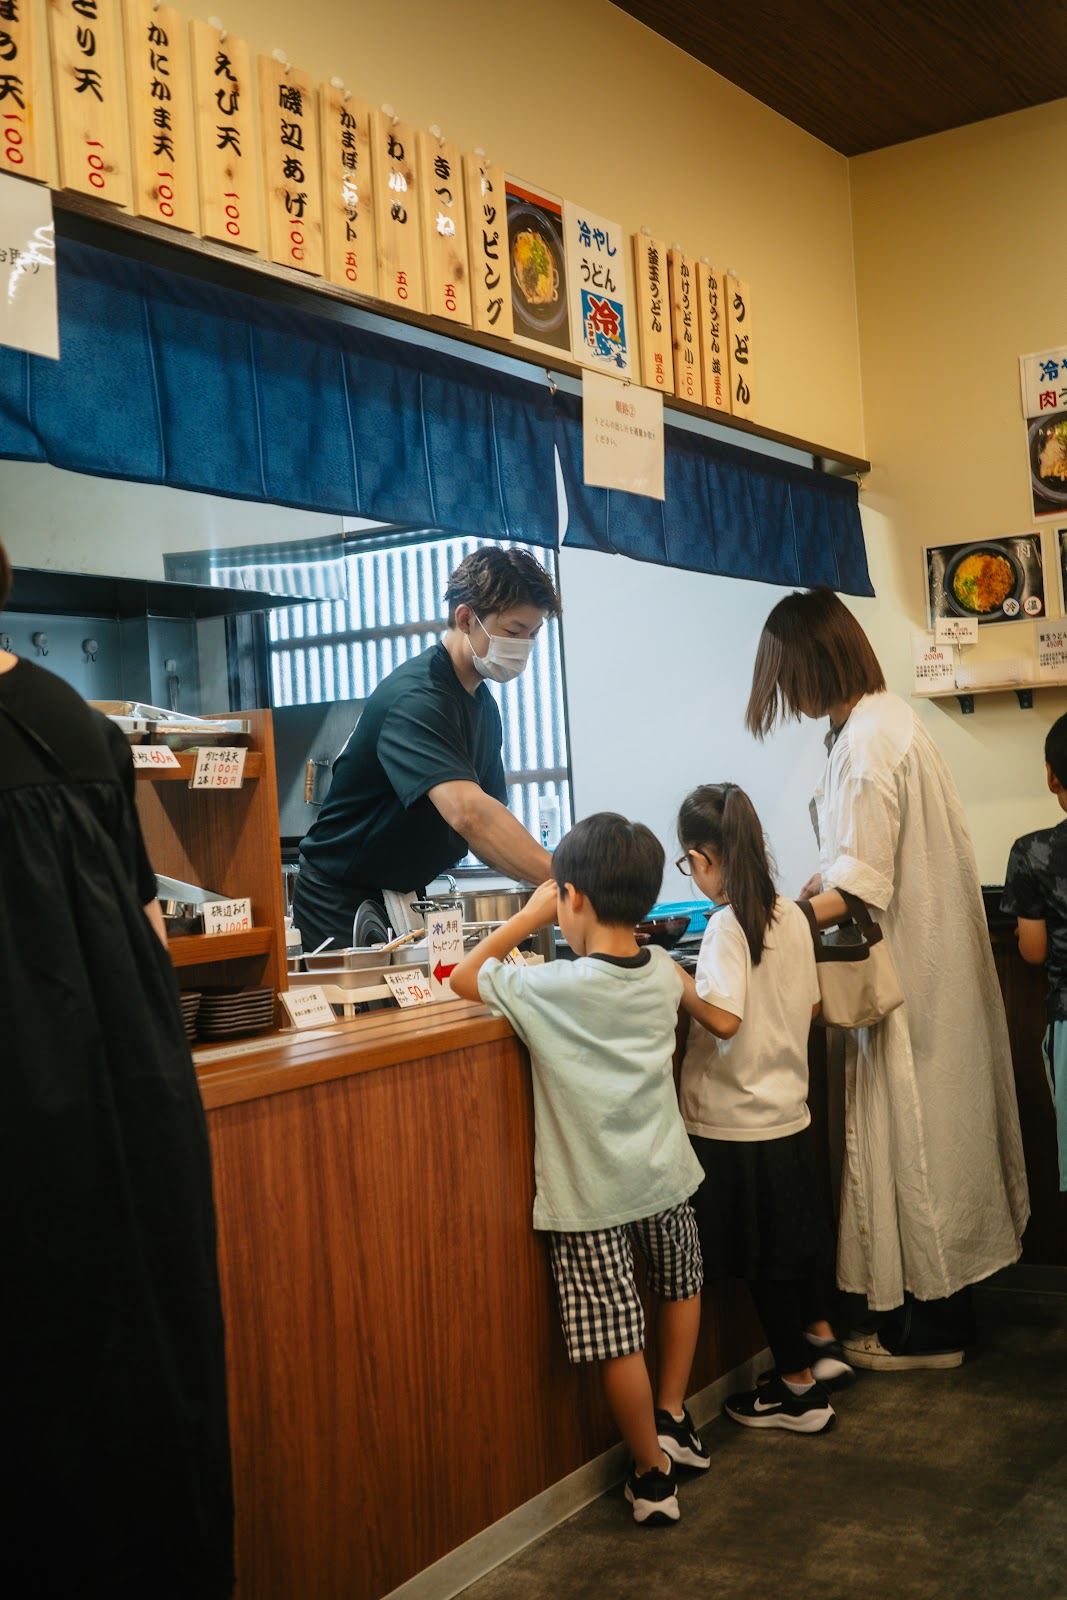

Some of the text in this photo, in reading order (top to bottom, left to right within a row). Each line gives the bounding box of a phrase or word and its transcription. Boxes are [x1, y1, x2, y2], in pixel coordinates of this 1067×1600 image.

[148, 21, 175, 162] かにかま天
[214, 51, 242, 157] えび天
[279, 84, 308, 218] 磯辺あげ
[576, 219, 617, 257] 冷やし
[580, 258, 617, 293] うどん
[733, 293, 751, 405] うどん
[150, 750, 174, 763] 60円
[205, 751, 240, 763] かにかま天
[213, 764, 239, 773] 100円
[407, 985, 431, 1000] 50円
